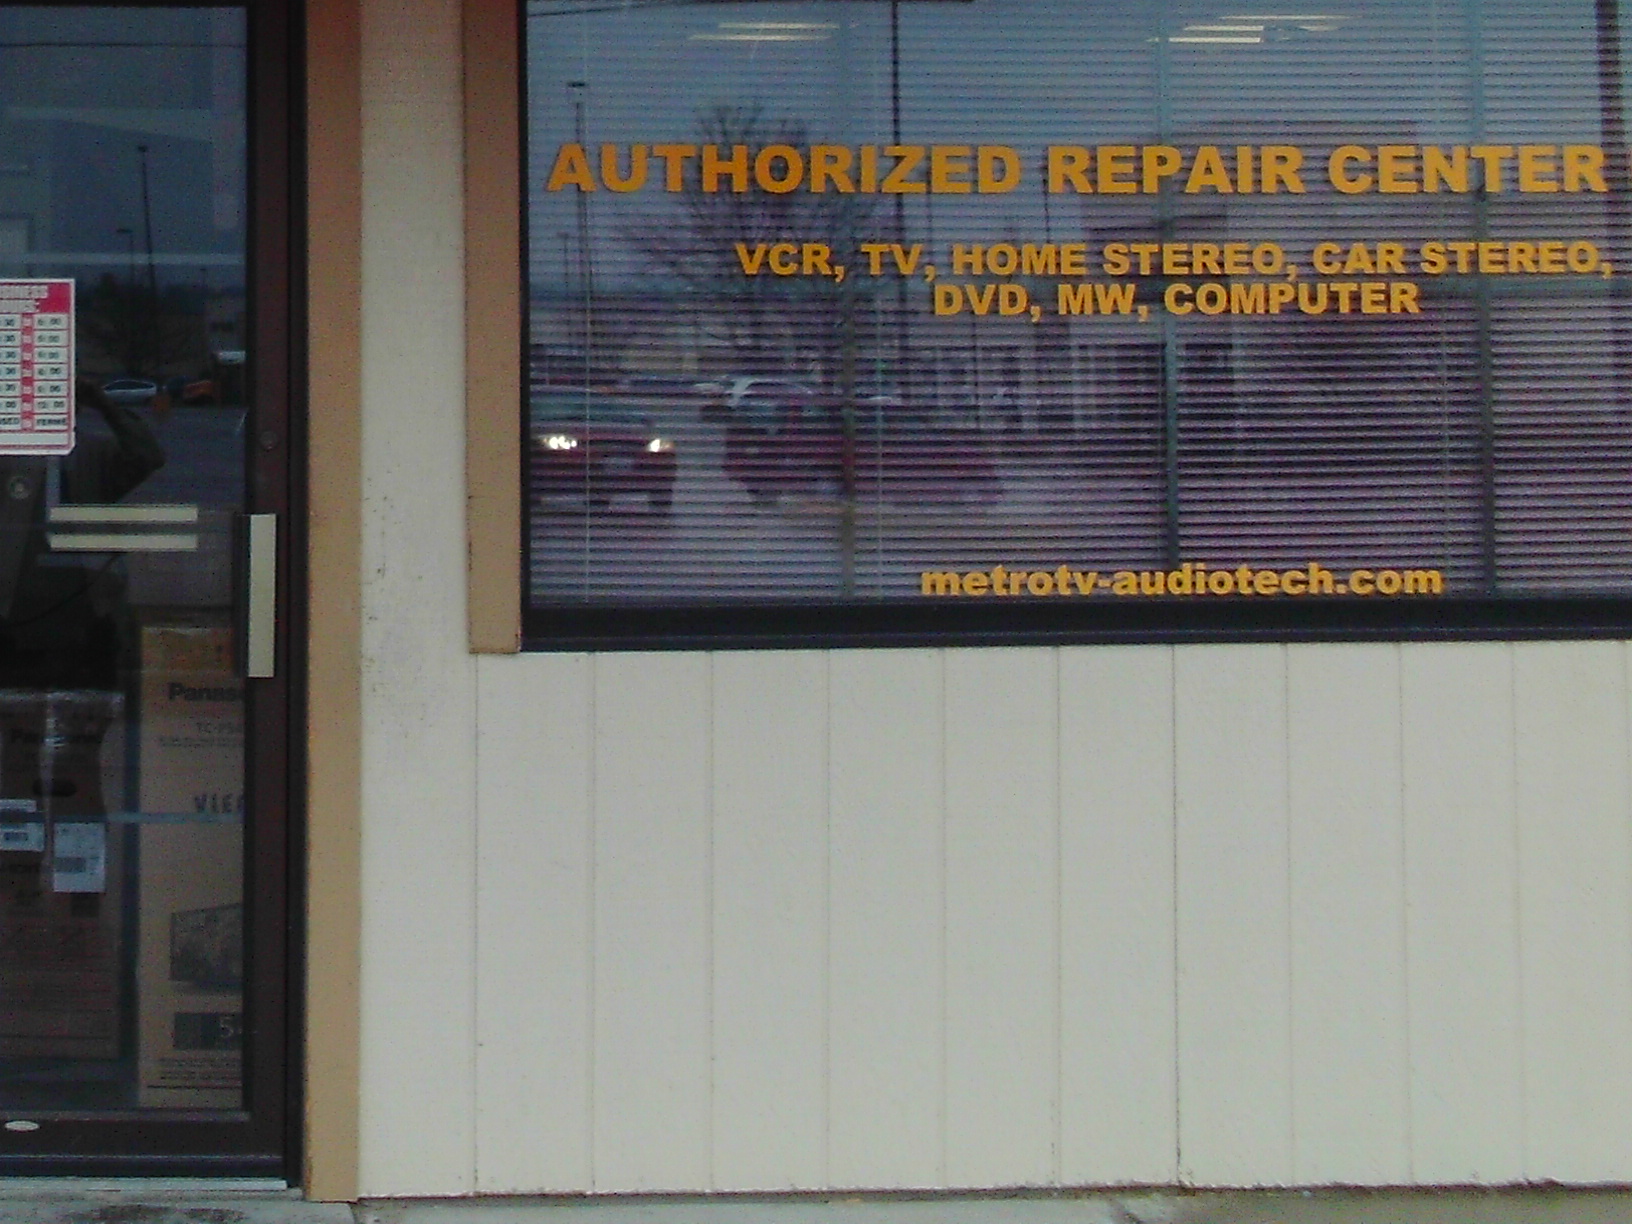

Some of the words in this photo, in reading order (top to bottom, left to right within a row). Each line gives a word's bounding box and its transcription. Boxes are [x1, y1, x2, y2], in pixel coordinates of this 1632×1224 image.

[547, 143, 1022, 195] AUTHORIZED
[1048, 144, 1306, 195] REPAIR
[1328, 143, 1611, 196] CENTER
[735, 242, 845, 281] VCR,
[860, 243, 936, 282] TV,
[953, 243, 1088, 276] HOME
[1103, 241, 1297, 281] STEREO,
[1313, 242, 1406, 276] CAR
[1420, 240, 1615, 280] STEREO,
[933, 283, 1042, 321] DVD,
[1057, 283, 1150, 321] MW,
[1164, 281, 1422, 317] COMPUTER
[921, 563, 1445, 596] metrotv-audiotech.com
